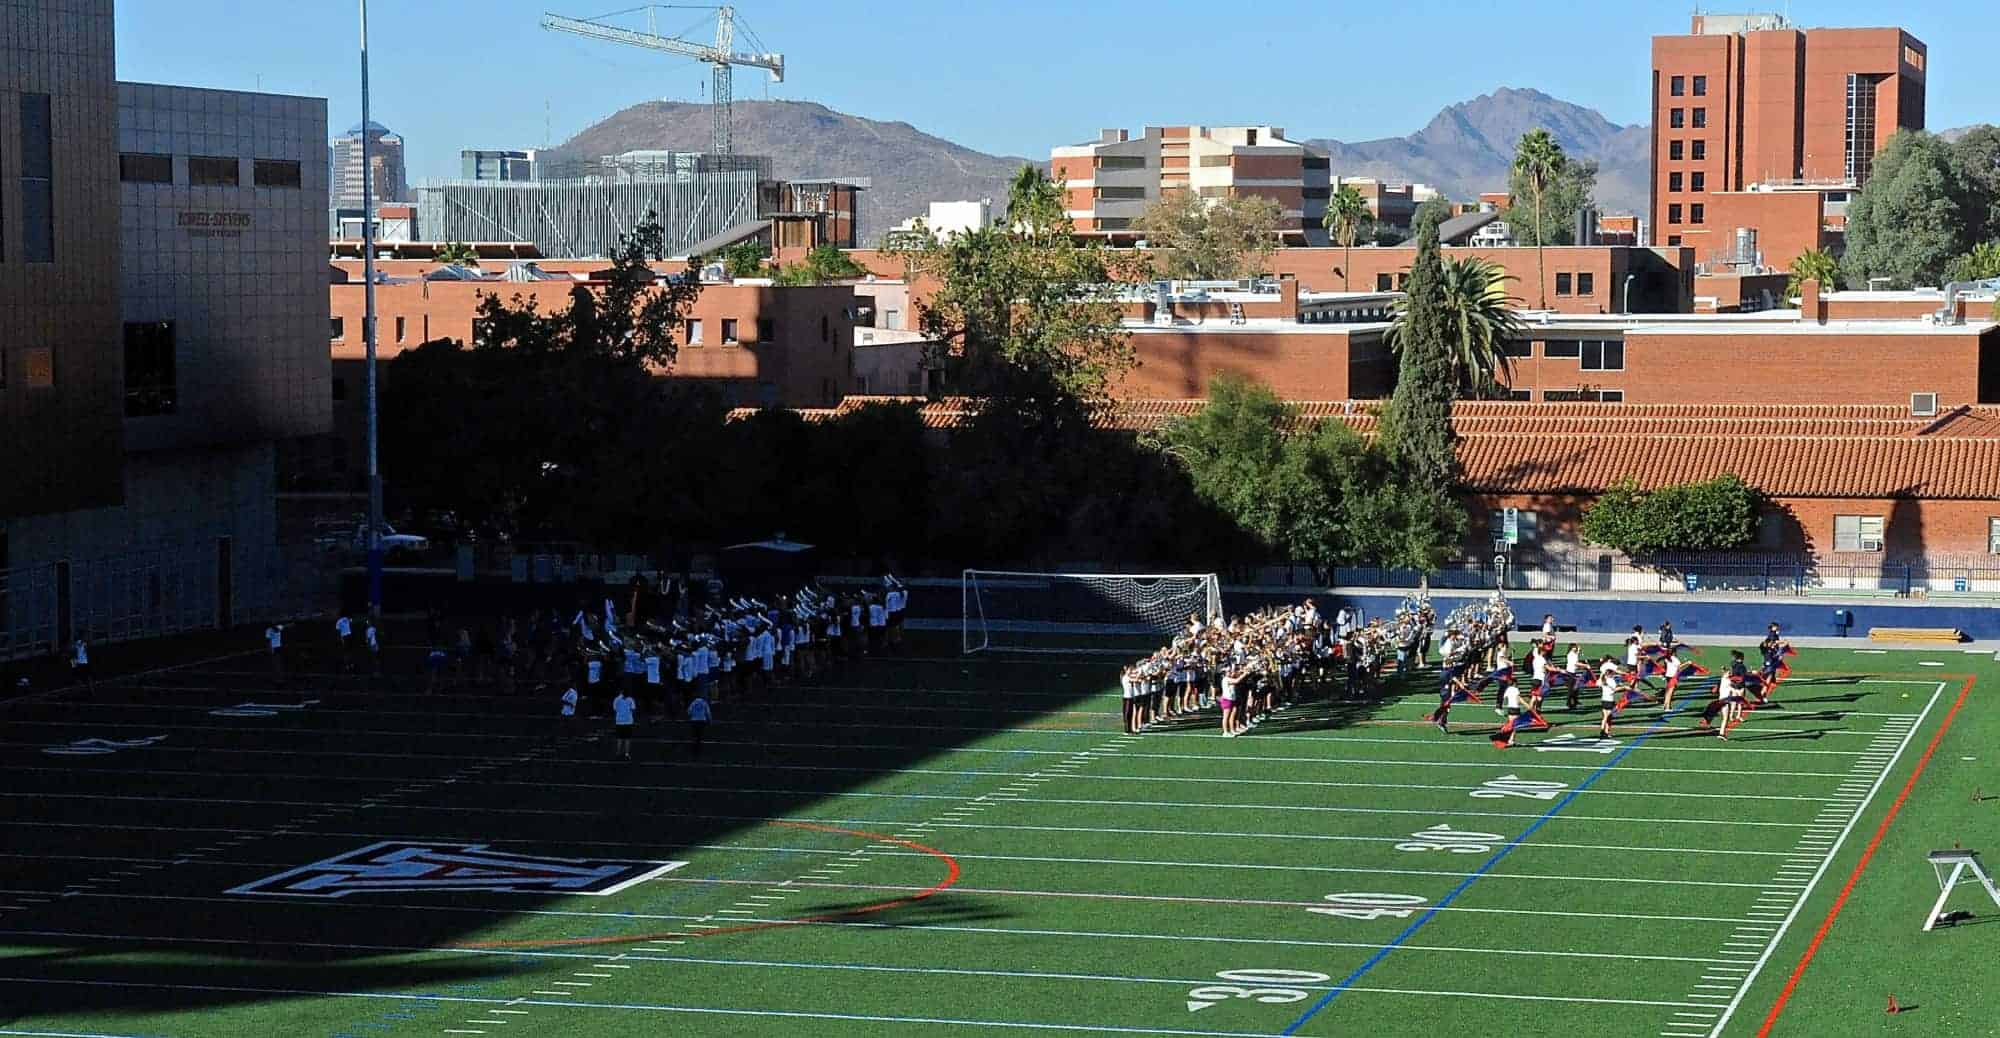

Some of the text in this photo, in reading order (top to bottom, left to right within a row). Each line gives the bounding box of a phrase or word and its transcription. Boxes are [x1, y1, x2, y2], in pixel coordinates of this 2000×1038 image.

[1468, 780, 1568, 800] 20
[1394, 831, 1505, 854] 30
[1306, 892, 1428, 919] 40
[1189, 969, 1330, 1004] 30
